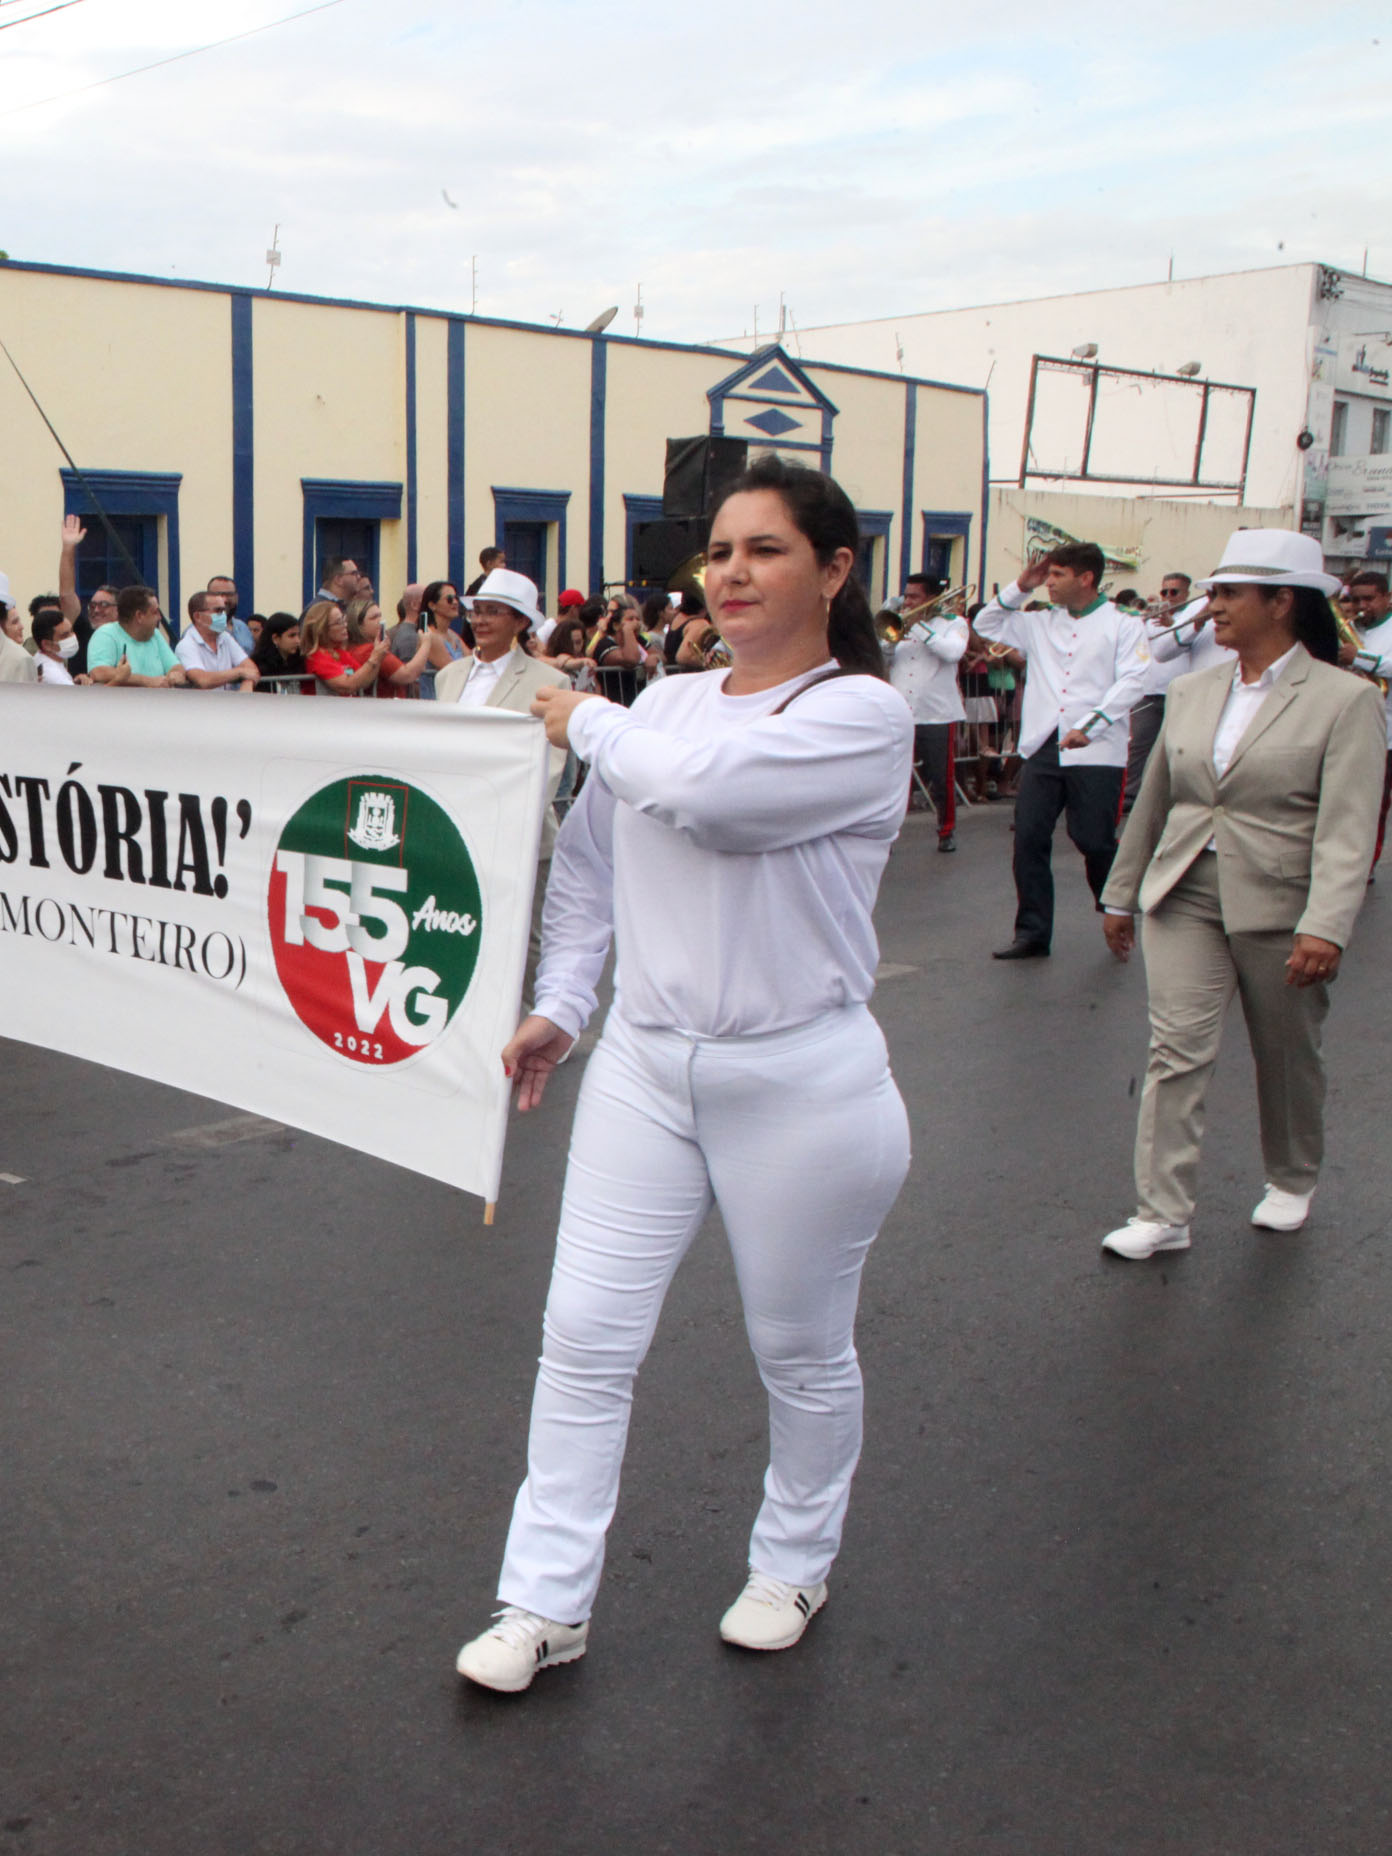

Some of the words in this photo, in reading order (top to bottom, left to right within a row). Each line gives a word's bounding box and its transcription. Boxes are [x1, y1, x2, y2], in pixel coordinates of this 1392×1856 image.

[275, 849, 409, 964] 155
[412, 894, 477, 937] Anos
[345, 950, 449, 1047] VG
[333, 1032, 384, 1060] 2022
